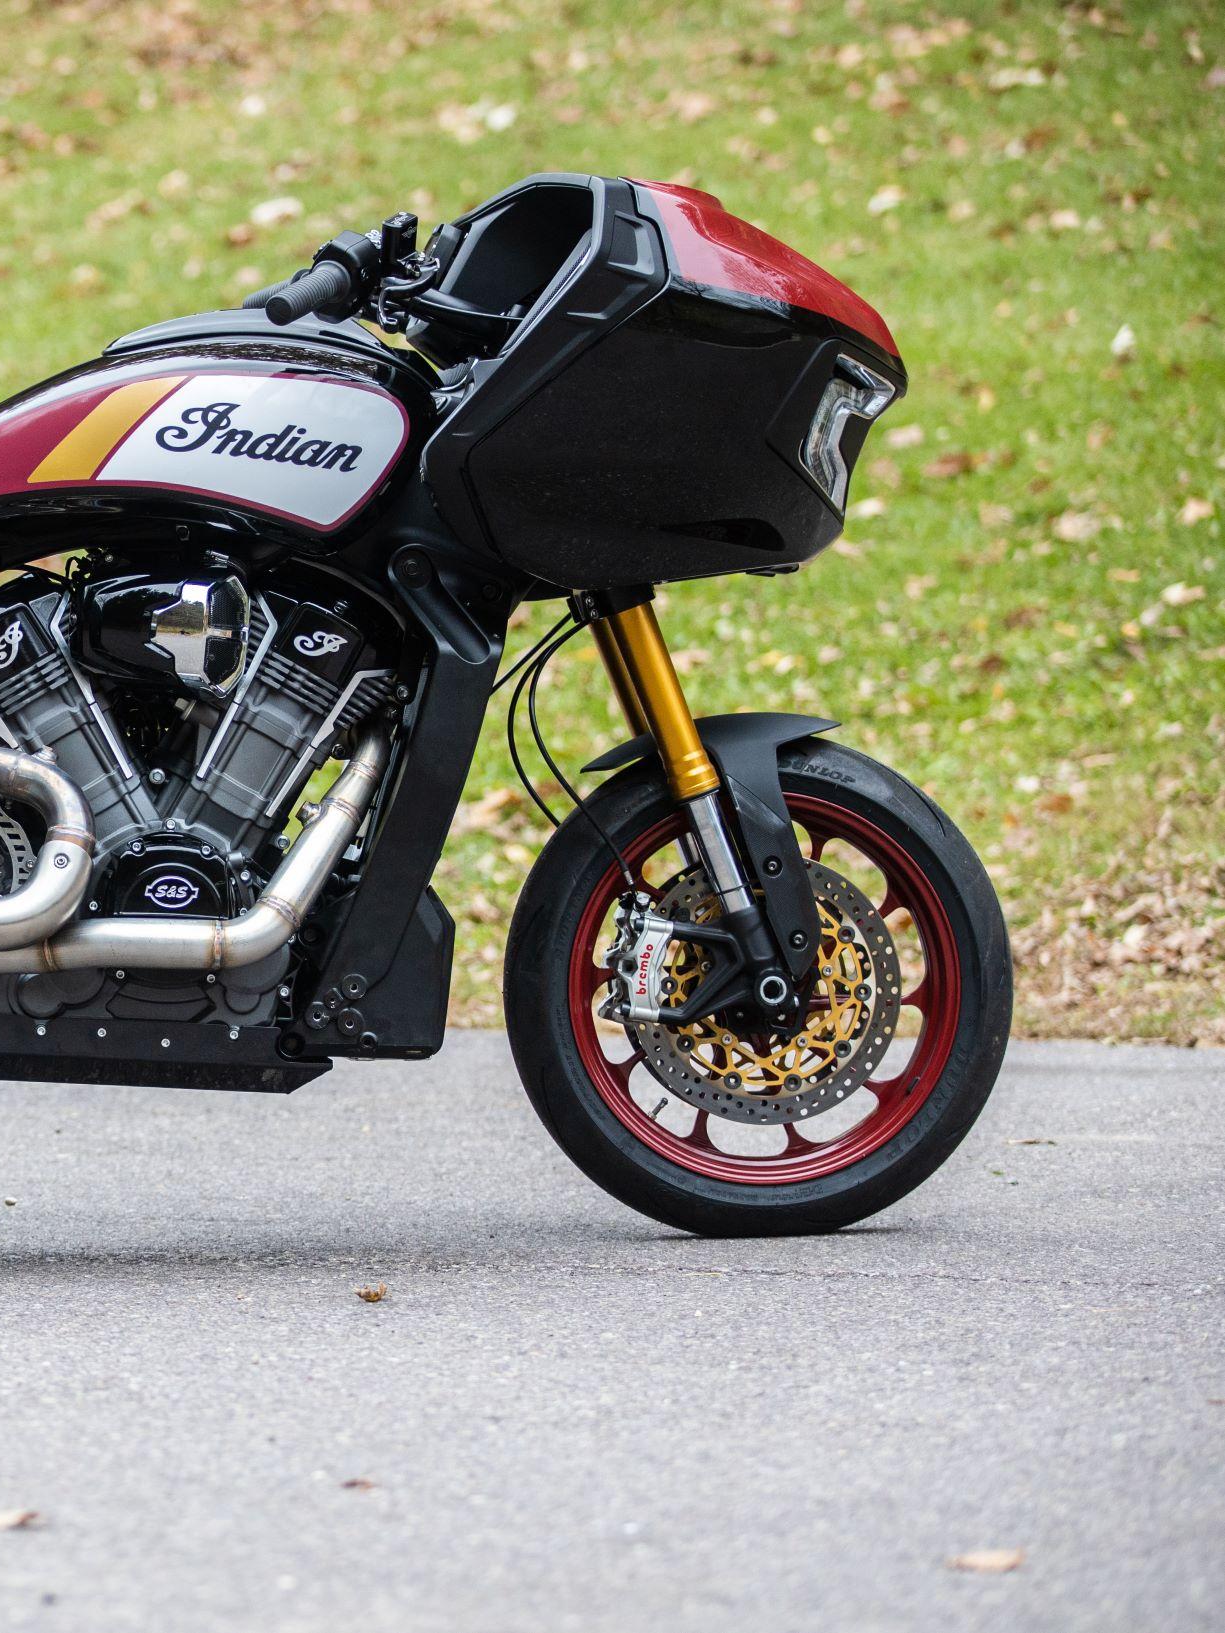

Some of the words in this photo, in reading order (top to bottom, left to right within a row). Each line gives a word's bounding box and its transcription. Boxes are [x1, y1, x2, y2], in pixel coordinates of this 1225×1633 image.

[156, 402, 363, 472] Indian
[777, 758, 856, 784] DUNLOP
[155, 884, 188, 899] S&S
